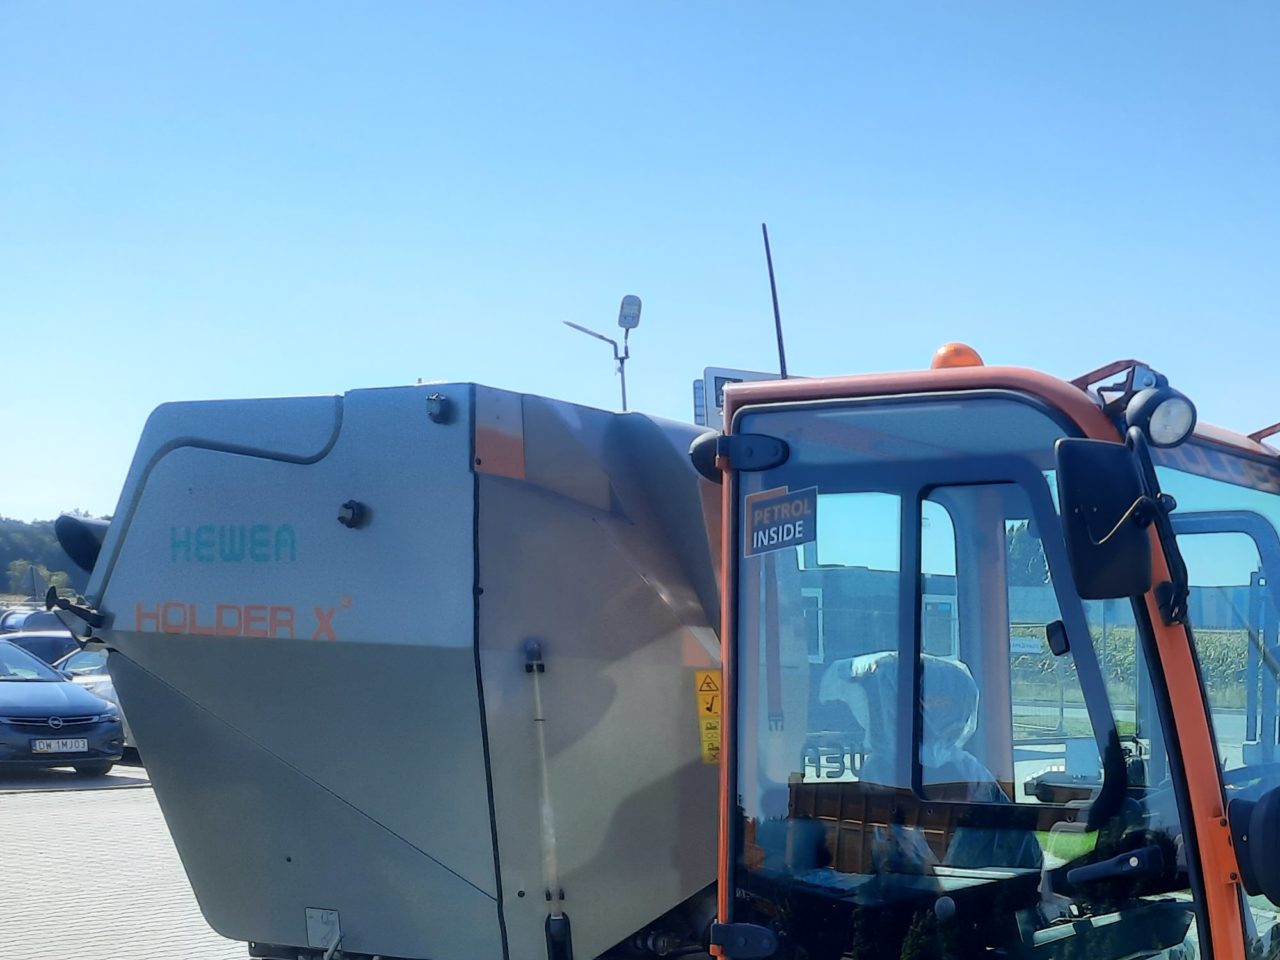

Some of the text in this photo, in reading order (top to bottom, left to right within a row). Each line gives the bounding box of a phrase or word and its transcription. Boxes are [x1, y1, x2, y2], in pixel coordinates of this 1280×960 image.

[753, 498, 811, 526] PETROL
[170, 523, 297, 563] HEWEA
[753, 520, 804, 548] INSIDE
[136, 602, 296, 640] HOLDER
